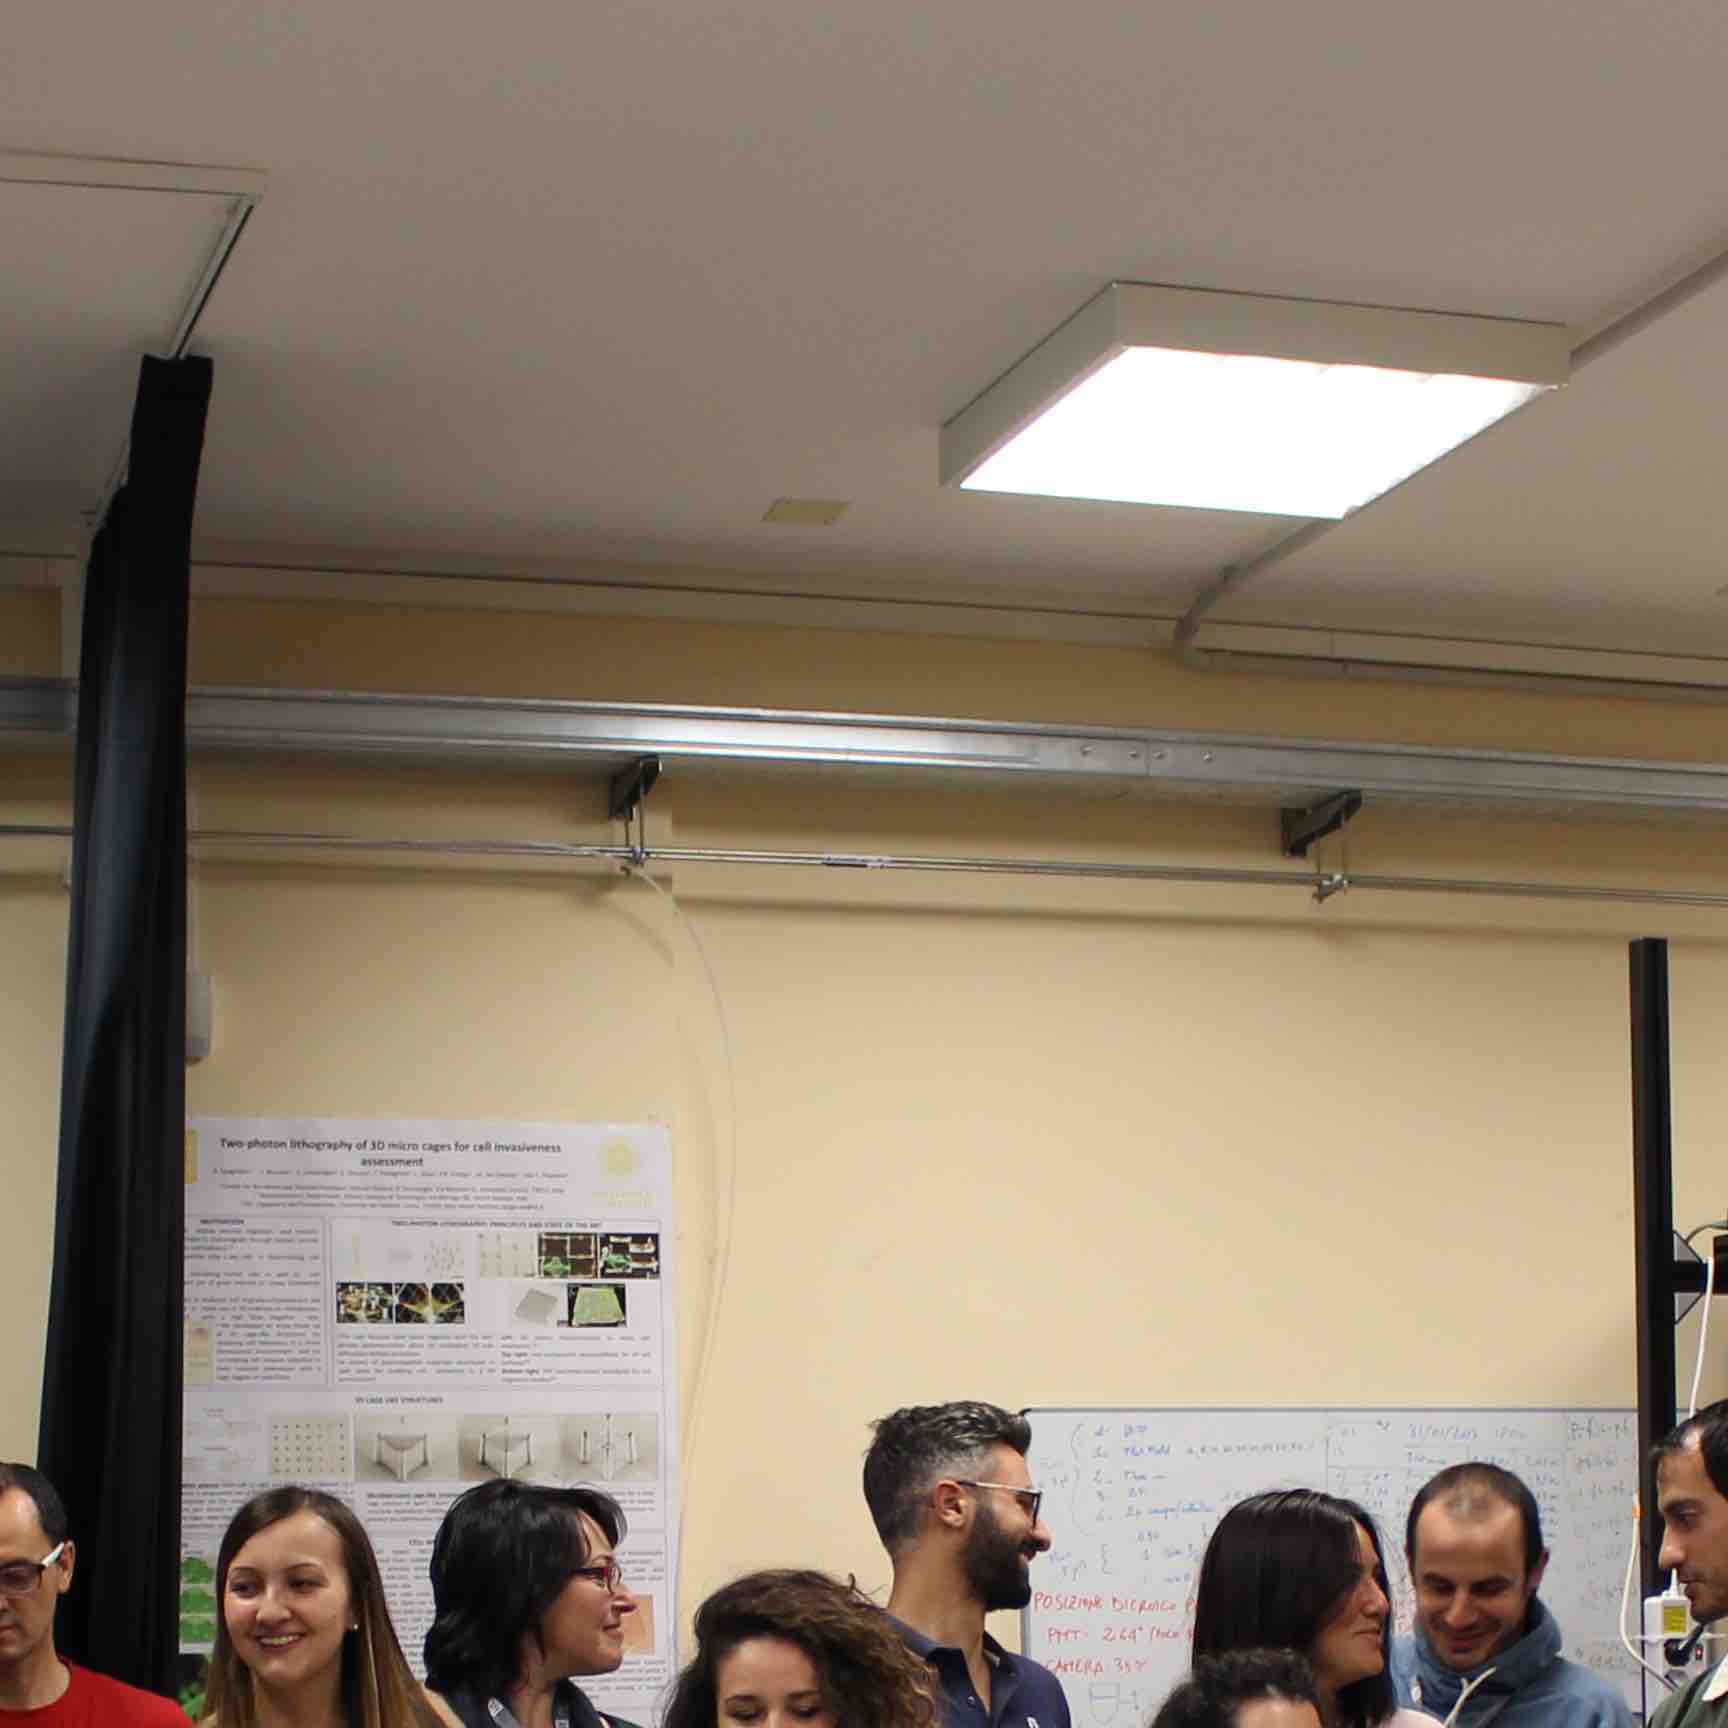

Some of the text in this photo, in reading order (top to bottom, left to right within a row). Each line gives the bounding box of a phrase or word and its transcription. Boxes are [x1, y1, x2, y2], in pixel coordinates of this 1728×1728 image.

[290, 1138, 353, 1153] lithography
[355, 1139, 368, 1151] of
[387, 1141, 419, 1151] micro
[422, 1143, 452, 1154] cages
[455, 1141, 470, 1151] for
[473, 1141, 491, 1152] cell
[494, 1141, 561, 1153] invasiveness
[361, 1157, 424, 1167] assessment
